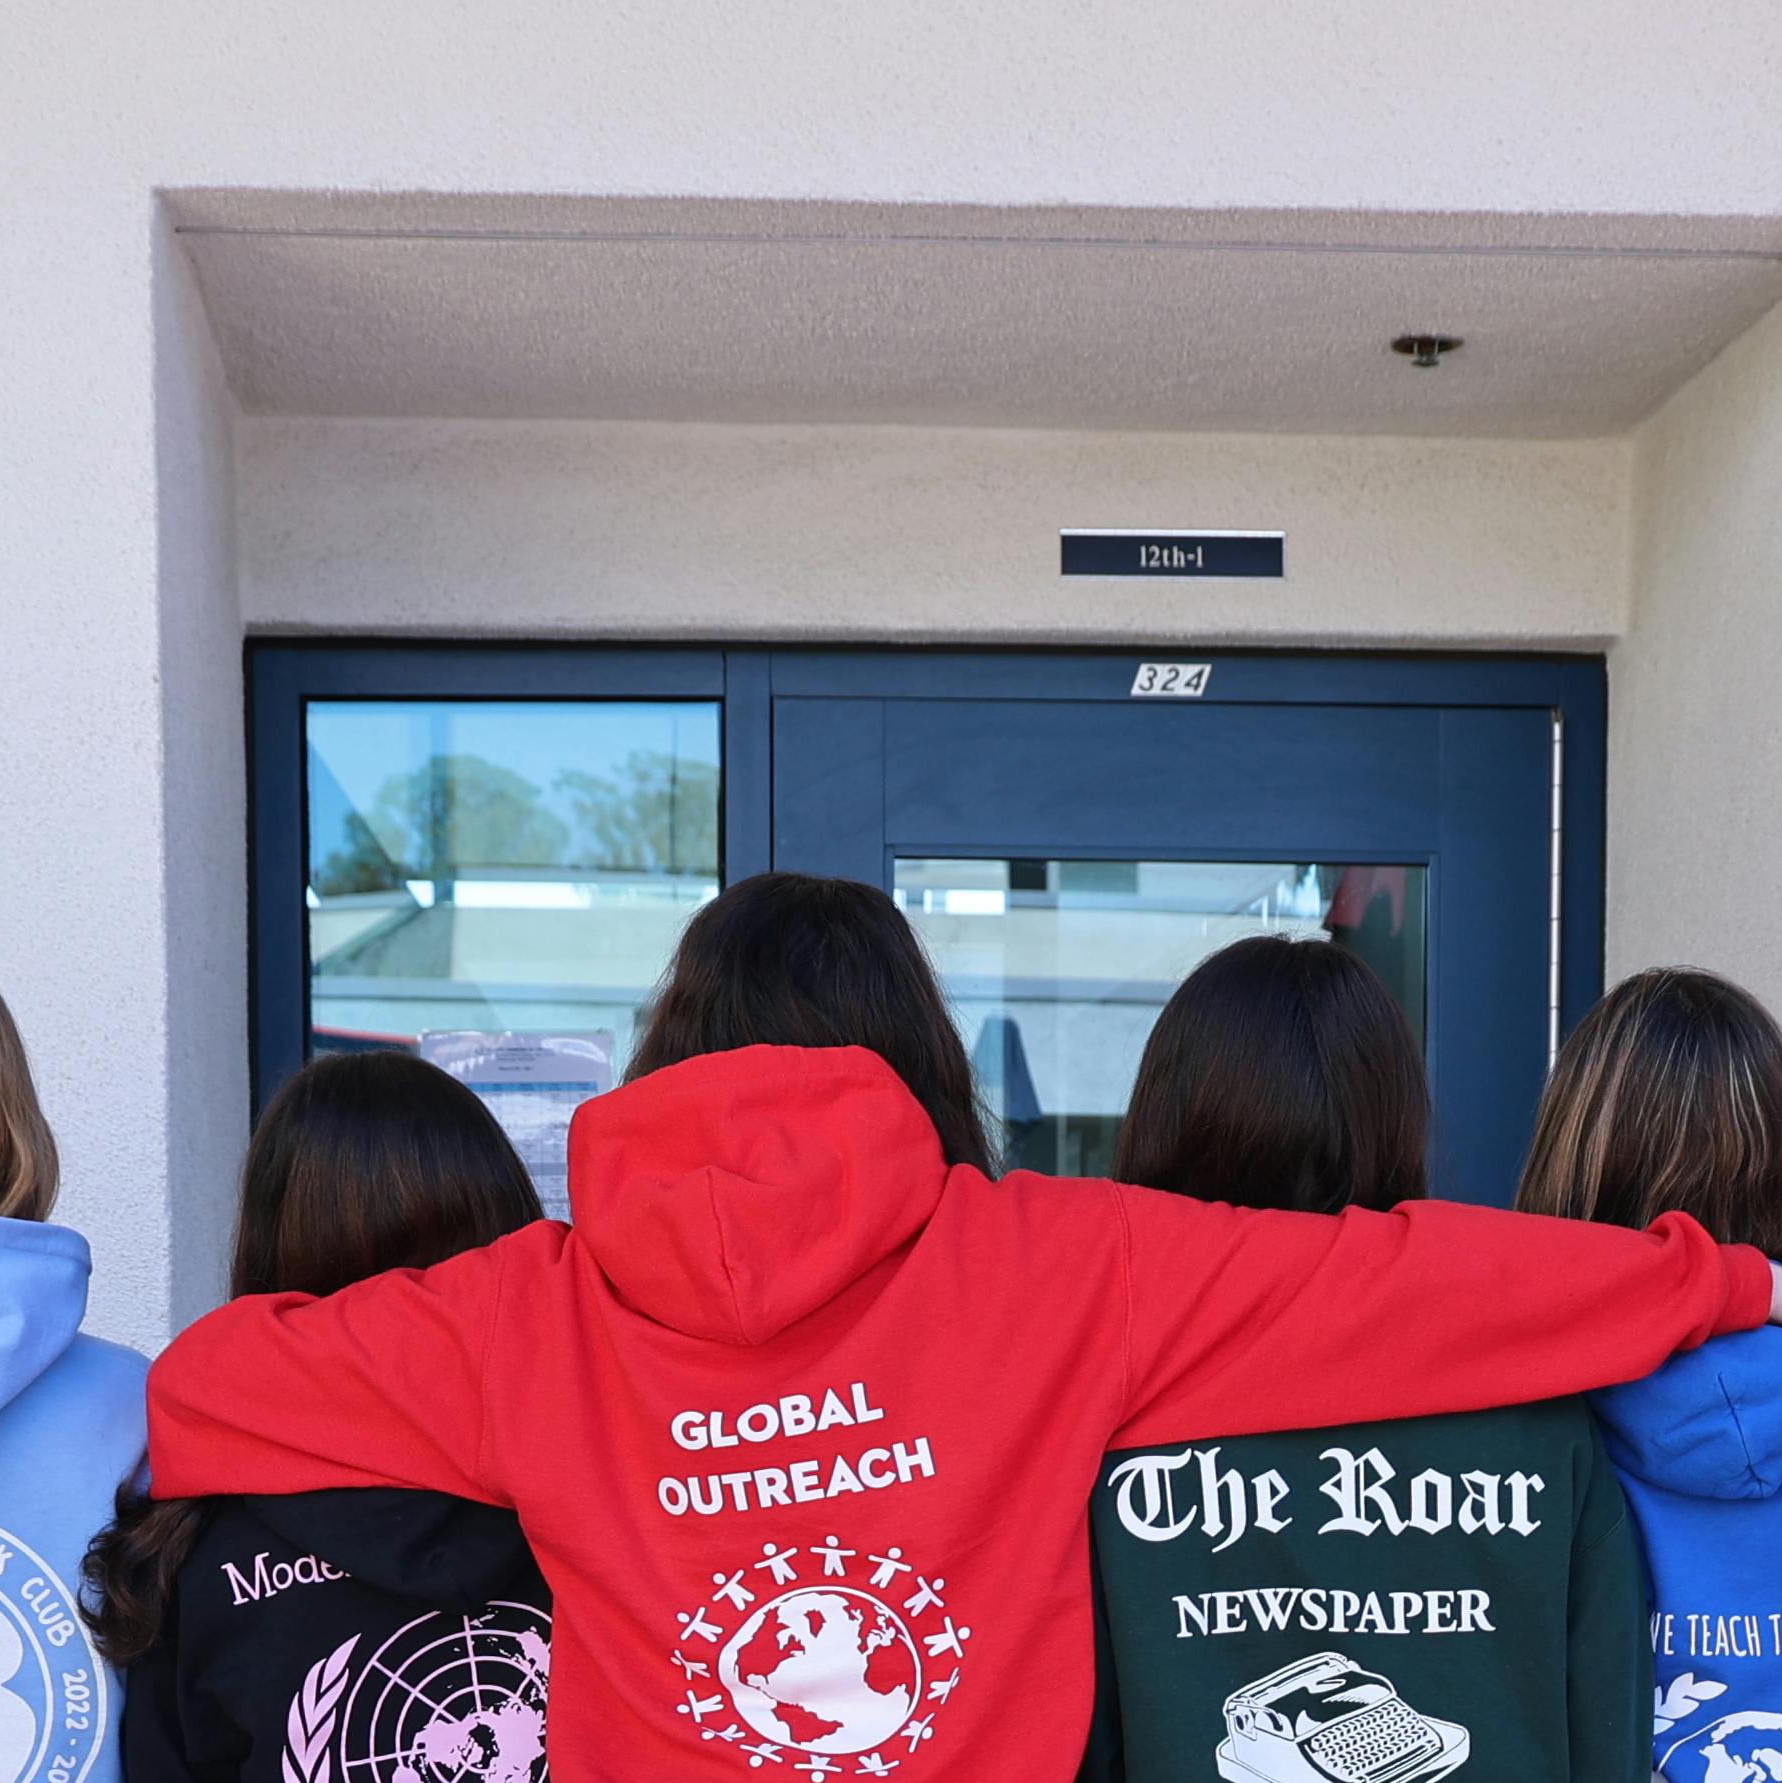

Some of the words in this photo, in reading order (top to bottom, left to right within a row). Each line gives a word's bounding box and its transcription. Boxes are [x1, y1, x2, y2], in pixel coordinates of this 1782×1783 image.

[1139, 545, 1204, 568] 12th-1
[1138, 666, 1207, 693] 324
[670, 1381, 884, 1451] GLOBAL
[657, 1436, 936, 1516] OUTREACH
[1107, 1446, 1294, 1554] The
[1317, 1446, 1546, 1538] Roar
[1172, 1588, 1496, 1638] NEWSPAPER
[1687, 1613, 1761, 1657] TEACH
[20, 1576, 75, 1648] CLUB
[62, 1668, 91, 1731] 2022
